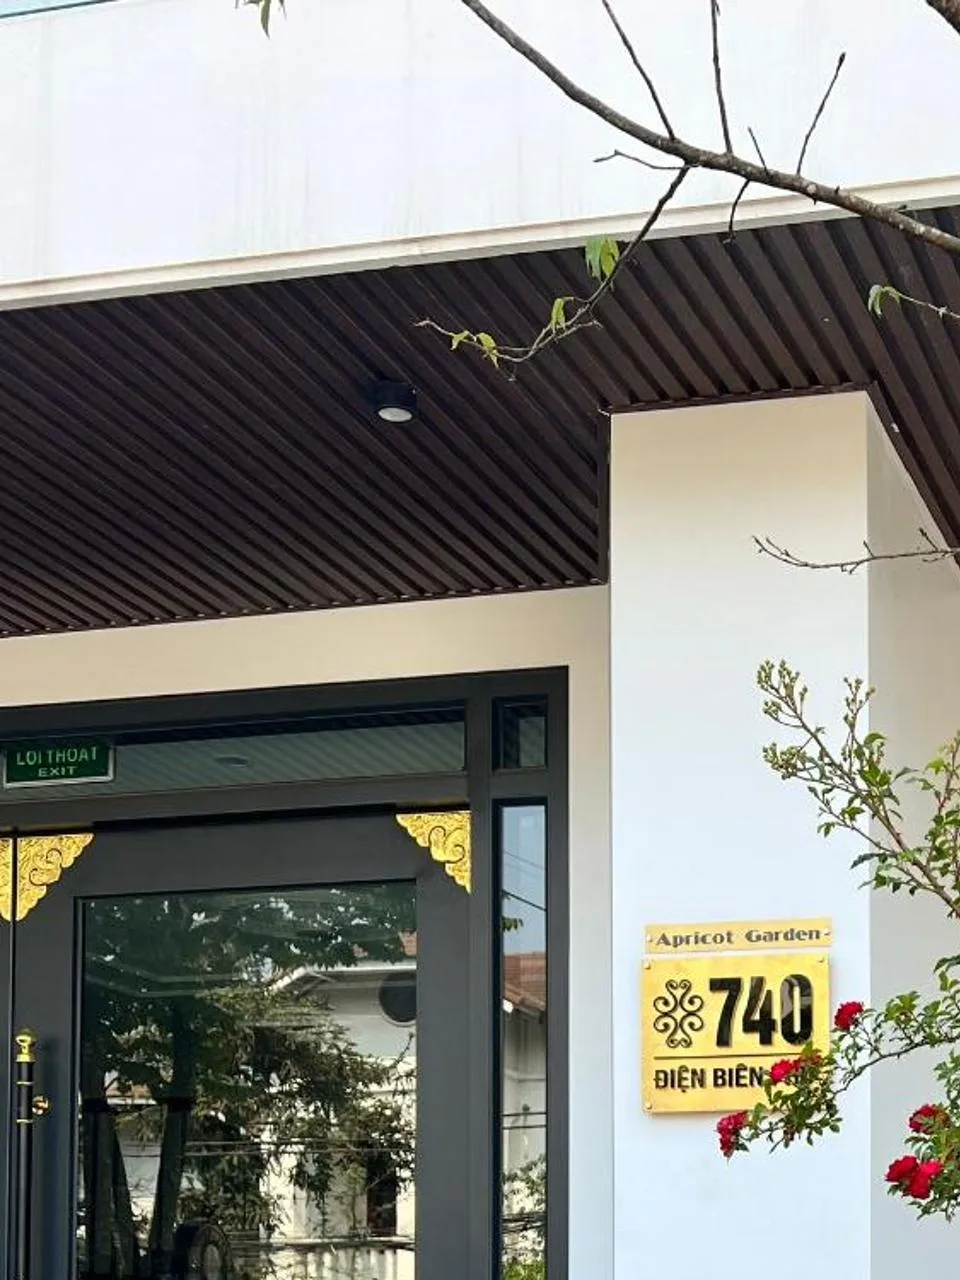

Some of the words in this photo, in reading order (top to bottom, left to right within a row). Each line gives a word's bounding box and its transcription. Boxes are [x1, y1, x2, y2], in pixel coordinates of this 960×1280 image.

[38, 765, 78, 778] EXIT
[655, 931, 735, 949] Apricot
[745, 927, 821, 944] Garden
[709, 973, 814, 1048] 740
[654, 1064, 705, 1093] ĐIỆN
[713, 1062, 765, 1089] BIÊN
